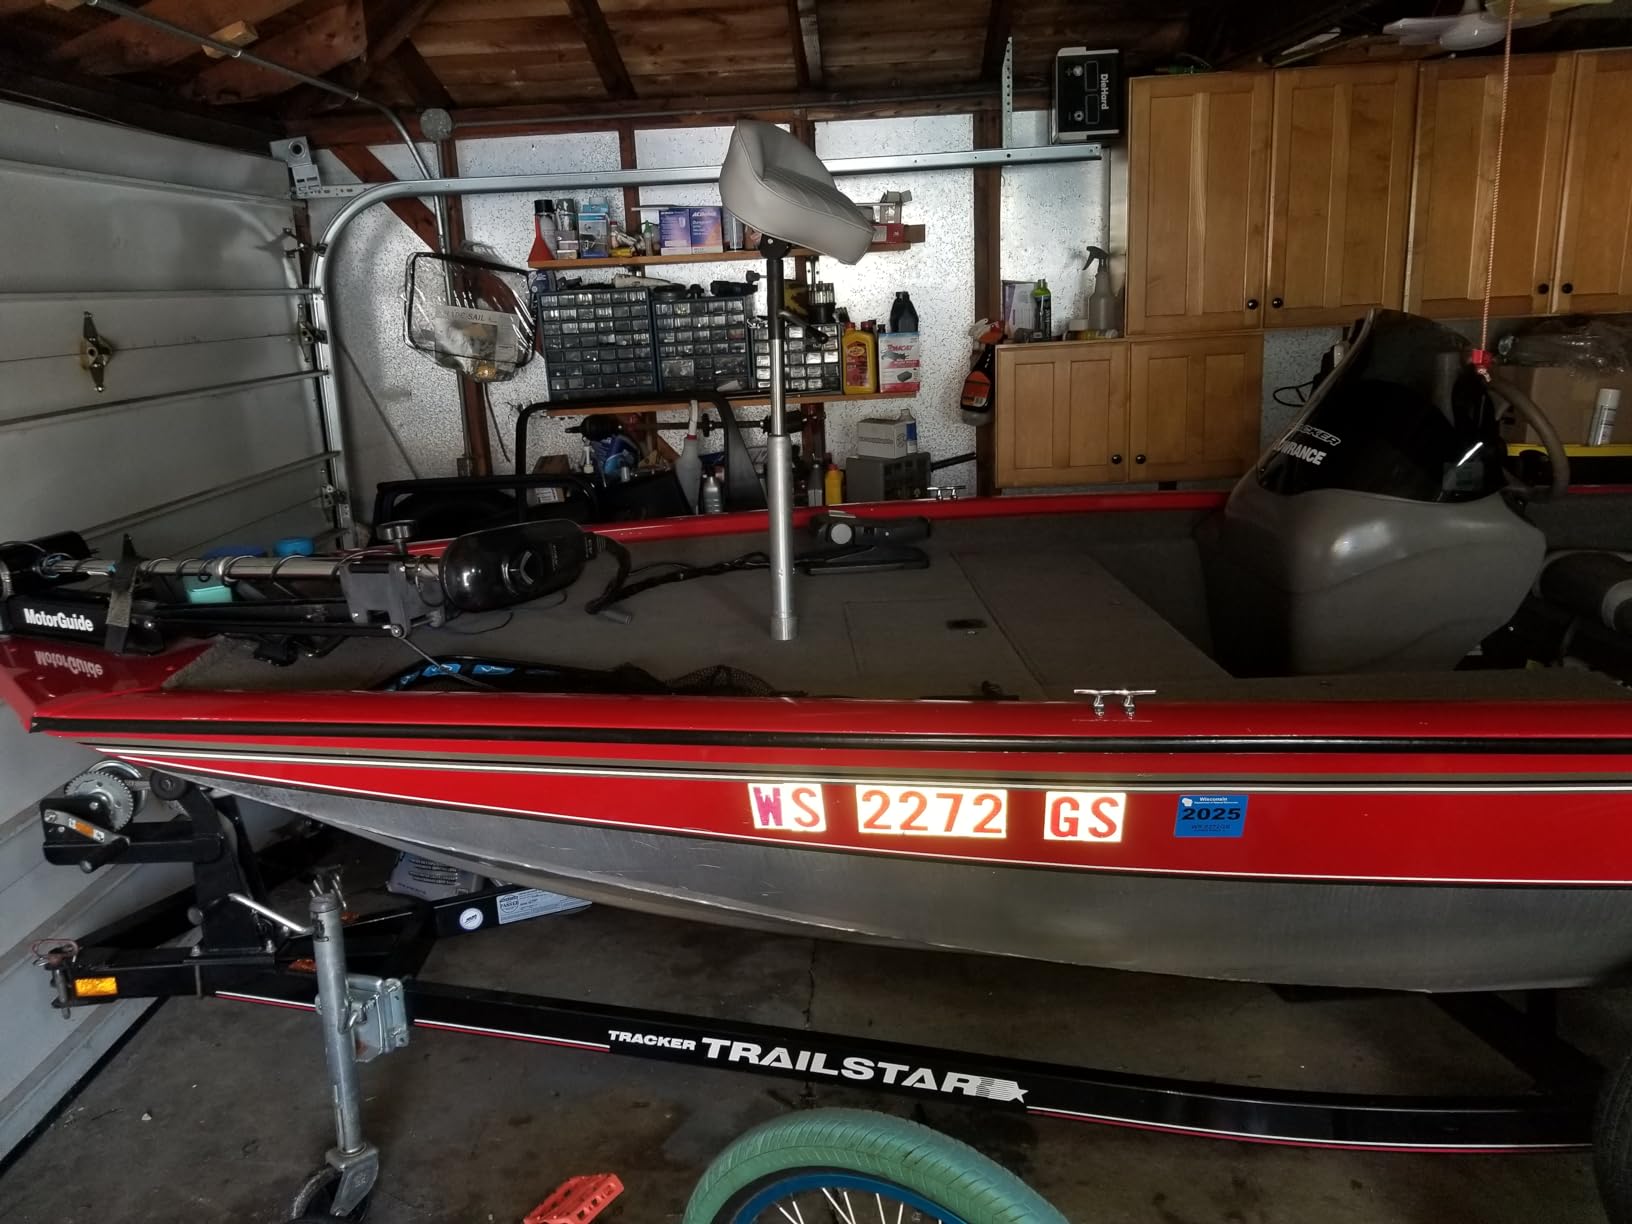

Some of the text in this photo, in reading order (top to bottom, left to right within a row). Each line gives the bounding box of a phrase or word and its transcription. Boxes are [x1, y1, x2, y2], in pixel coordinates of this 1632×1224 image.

[1100, 73, 1109, 110] DieHard
[23, 607, 94, 632] MotorGuide
[753, 786, 1118, 838] WS 2272 GS
[1181, 807, 1241, 821] 2025
[608, 1030, 983, 1097] TRACKER TRAILSTAR
